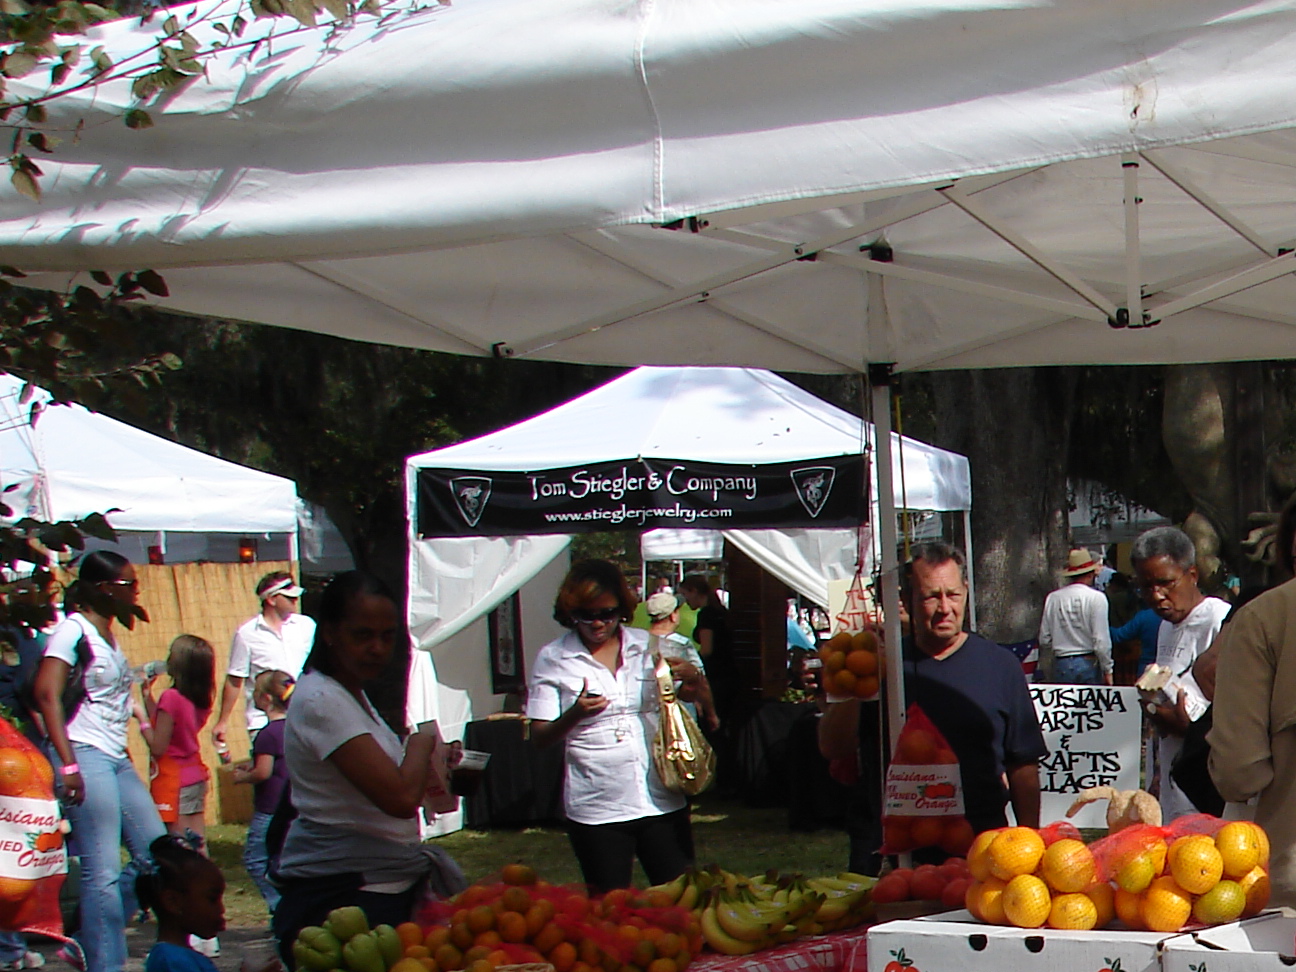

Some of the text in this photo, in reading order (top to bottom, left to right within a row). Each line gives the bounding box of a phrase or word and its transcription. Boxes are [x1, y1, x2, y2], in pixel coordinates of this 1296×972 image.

[527, 466, 757, 501] Tom Stiegler & Company
[545, 502, 732, 526] www.stieglerjewelry.com
[1029, 687, 1127, 712] OUISIANA
[1041, 711, 1104, 734] ARTS
[1038, 751, 1121, 773] RAFTS
[1040, 772, 1118, 794] LLAGE
[0, 806, 60, 827] isiana
